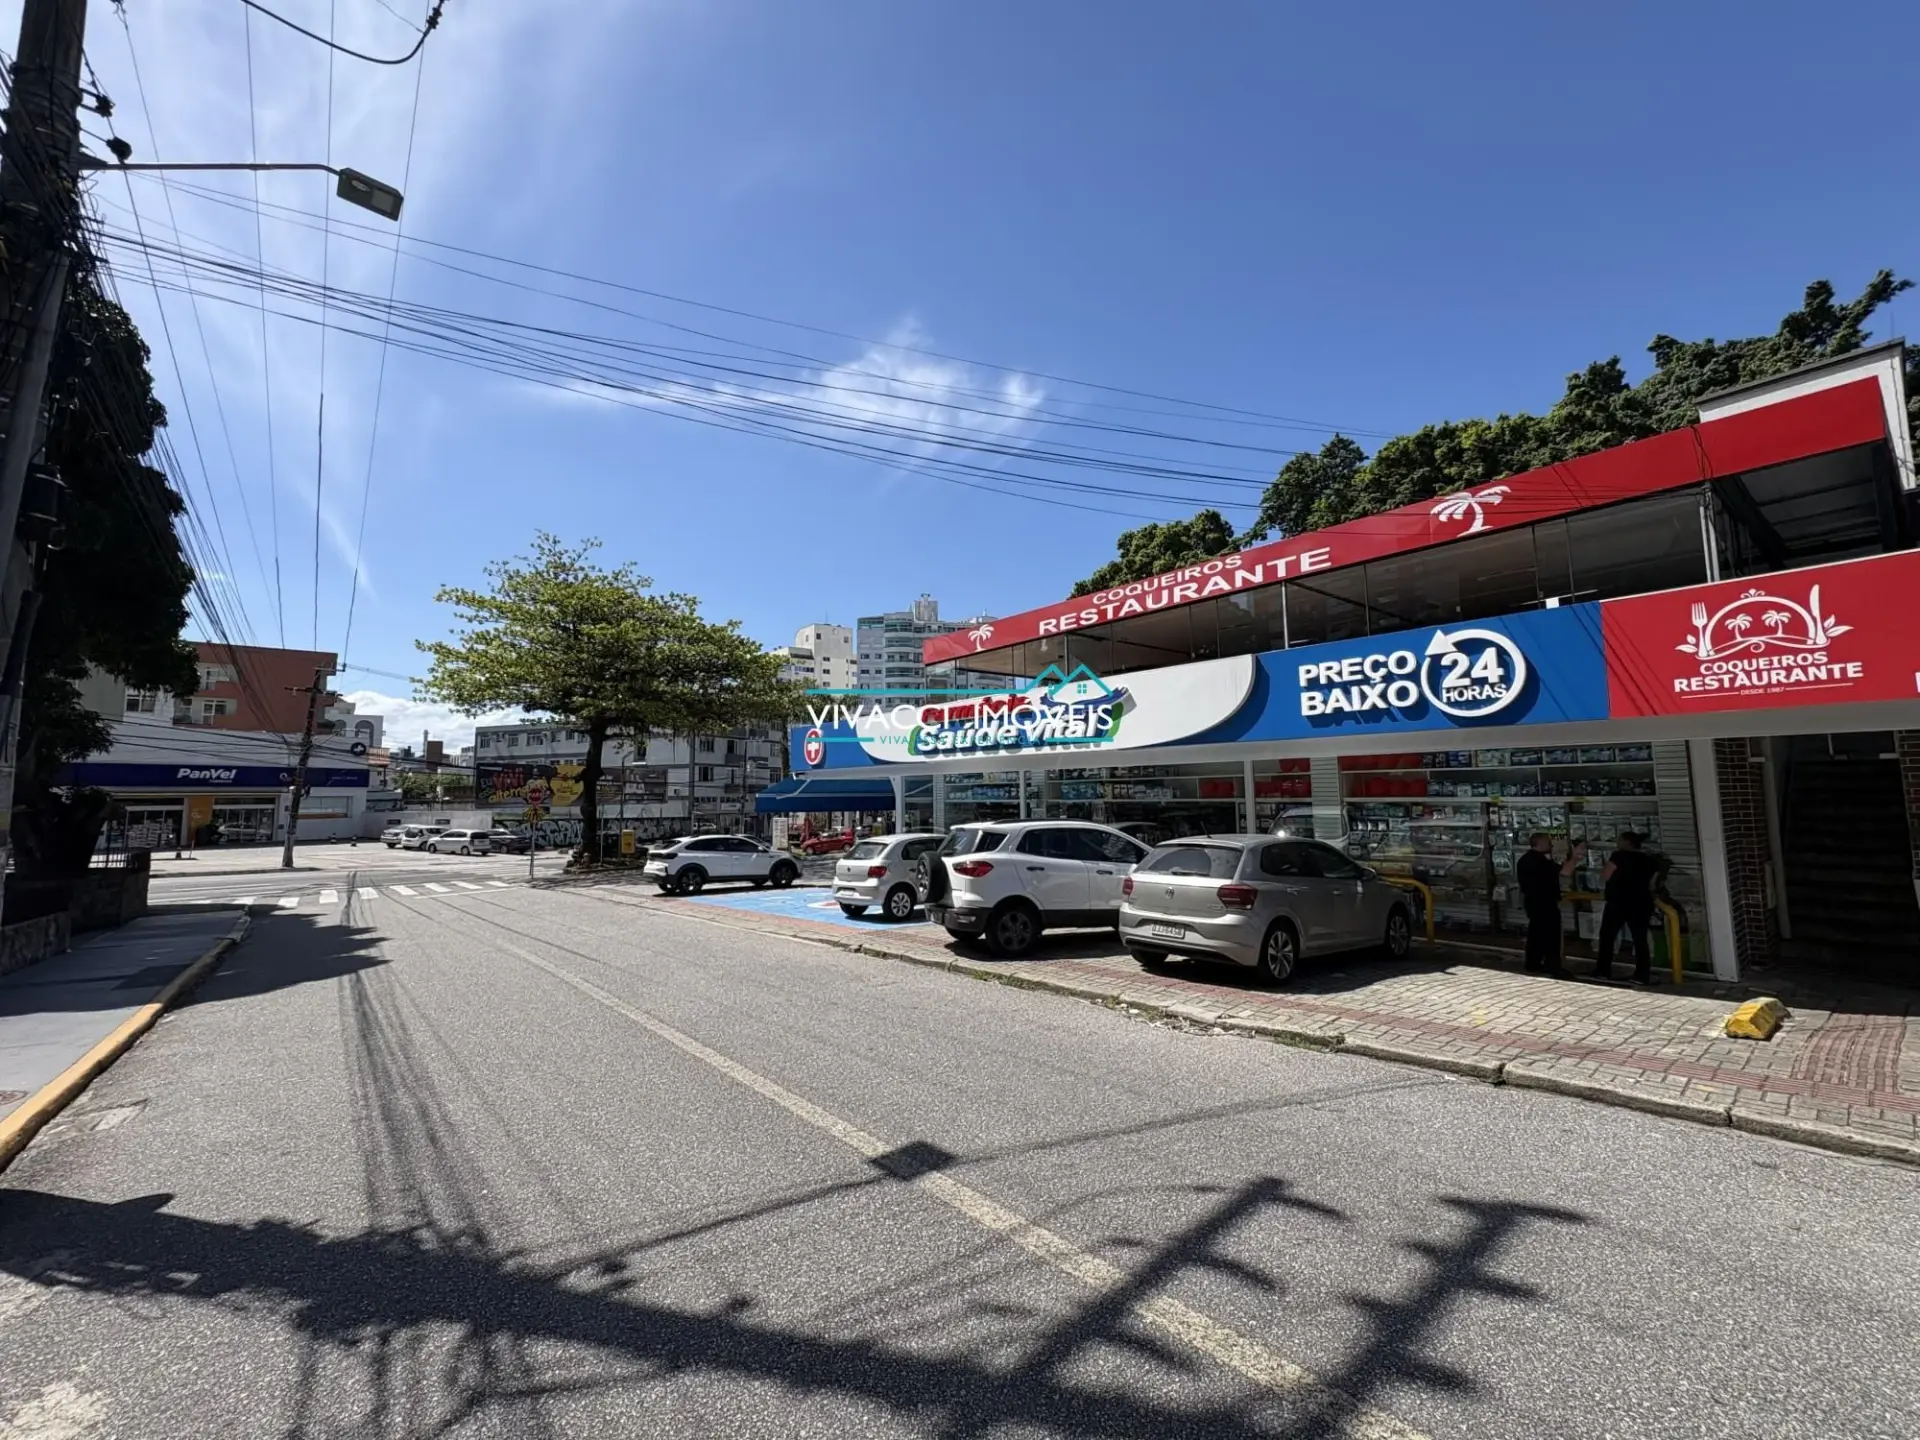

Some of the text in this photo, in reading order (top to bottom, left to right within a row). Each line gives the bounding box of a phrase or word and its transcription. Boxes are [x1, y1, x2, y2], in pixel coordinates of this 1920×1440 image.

[1038, 546, 1332, 635] RESTAURANTE
[1093, 554, 1243, 605] COQUEIROS
[1298, 650, 1417, 683] PREÇO
[1440, 646, 1505, 689] 24
[1673, 662, 1865, 693] RESTAURANTE
[1699, 651, 1829, 676] COQUEIROS
[1301, 680, 1420, 716] BAIXO
[1442, 681, 1508, 704] HORAS
[1740, 687, 1765, 696] DESDE
[916, 717, 1019, 752] Saúde
